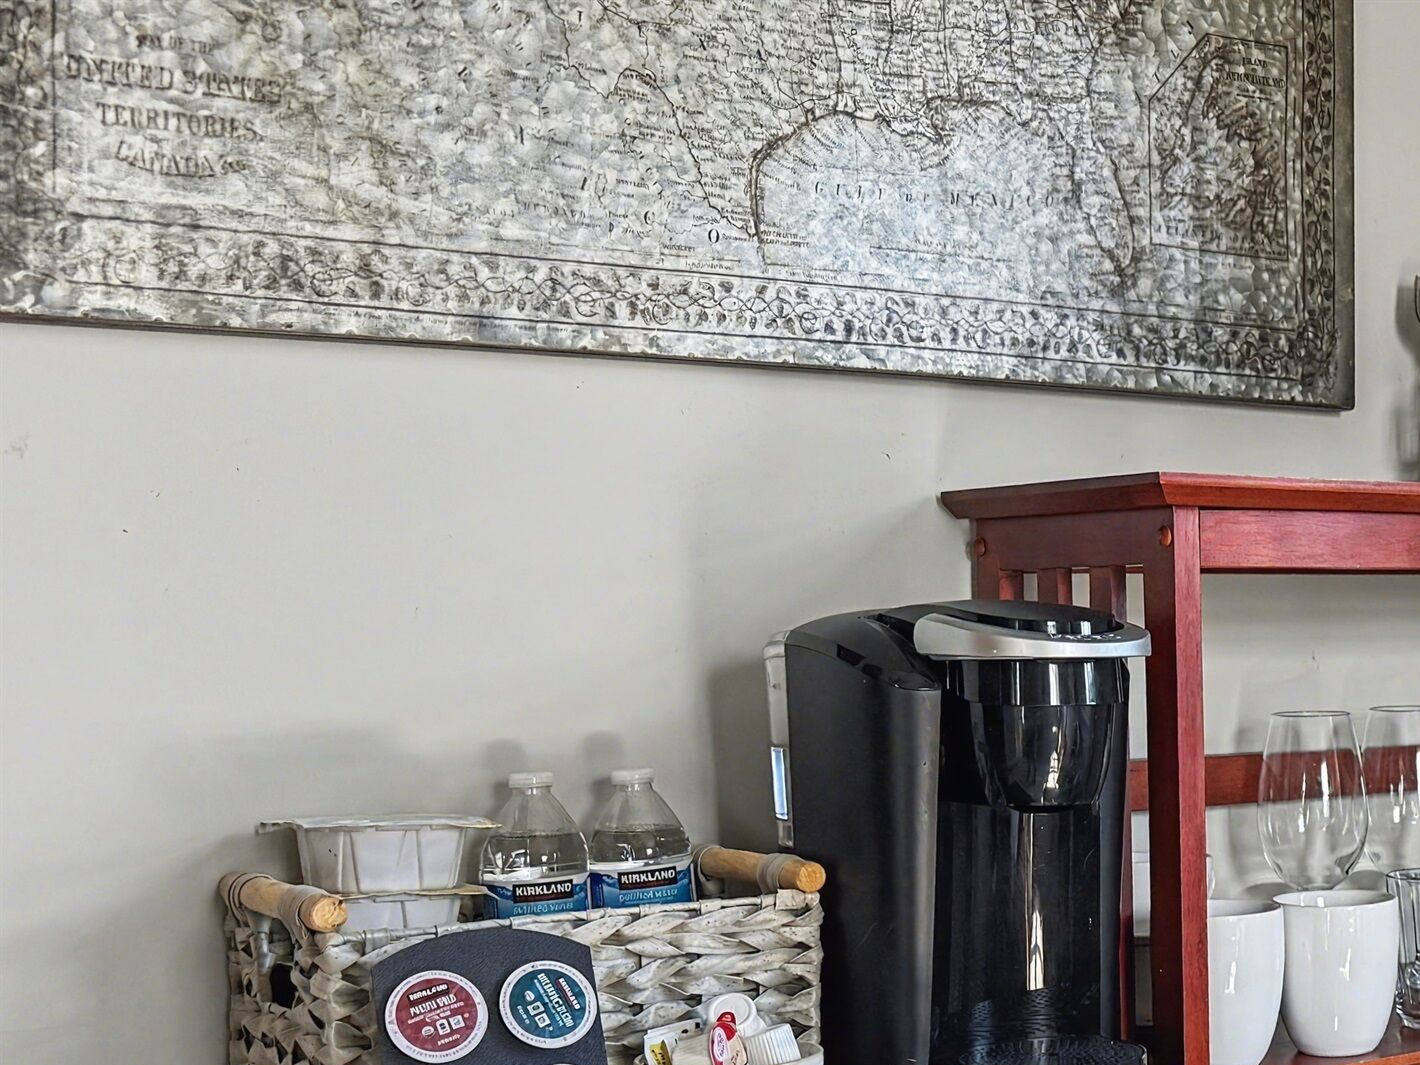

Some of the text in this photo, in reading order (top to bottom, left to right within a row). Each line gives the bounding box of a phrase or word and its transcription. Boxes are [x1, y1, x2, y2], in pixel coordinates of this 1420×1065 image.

[63, 53, 282, 103] UNITED STATES
[621, 869, 676, 884] KIRKLAND
[515, 882, 572, 897] KIRKLAND
